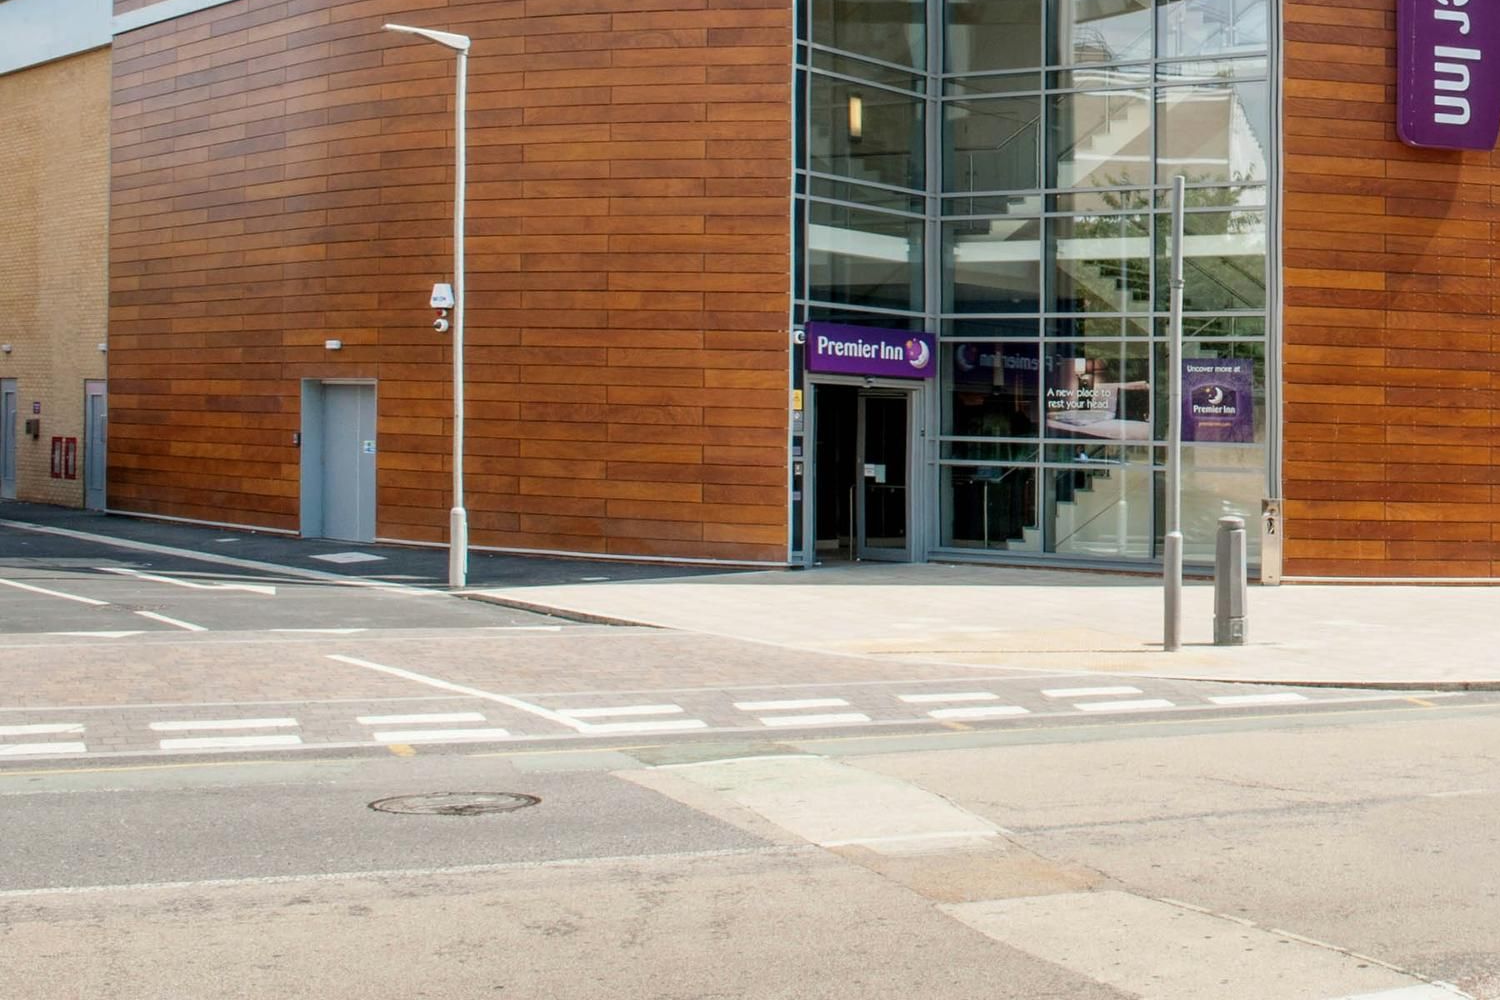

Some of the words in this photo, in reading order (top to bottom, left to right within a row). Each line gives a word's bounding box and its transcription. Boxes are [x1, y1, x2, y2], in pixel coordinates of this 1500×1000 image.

[1434, 45, 1481, 125] Inn
[817, 335, 880, 359] Premier
[880, 341, 904, 361] Inn
[1186, 364, 1214, 373] Uncover
[1046, 387, 1055, 397] A
[1056, 389, 1073, 398] new
[1066, 400, 1086, 410] your
[1193, 404, 1222, 414] Premier
